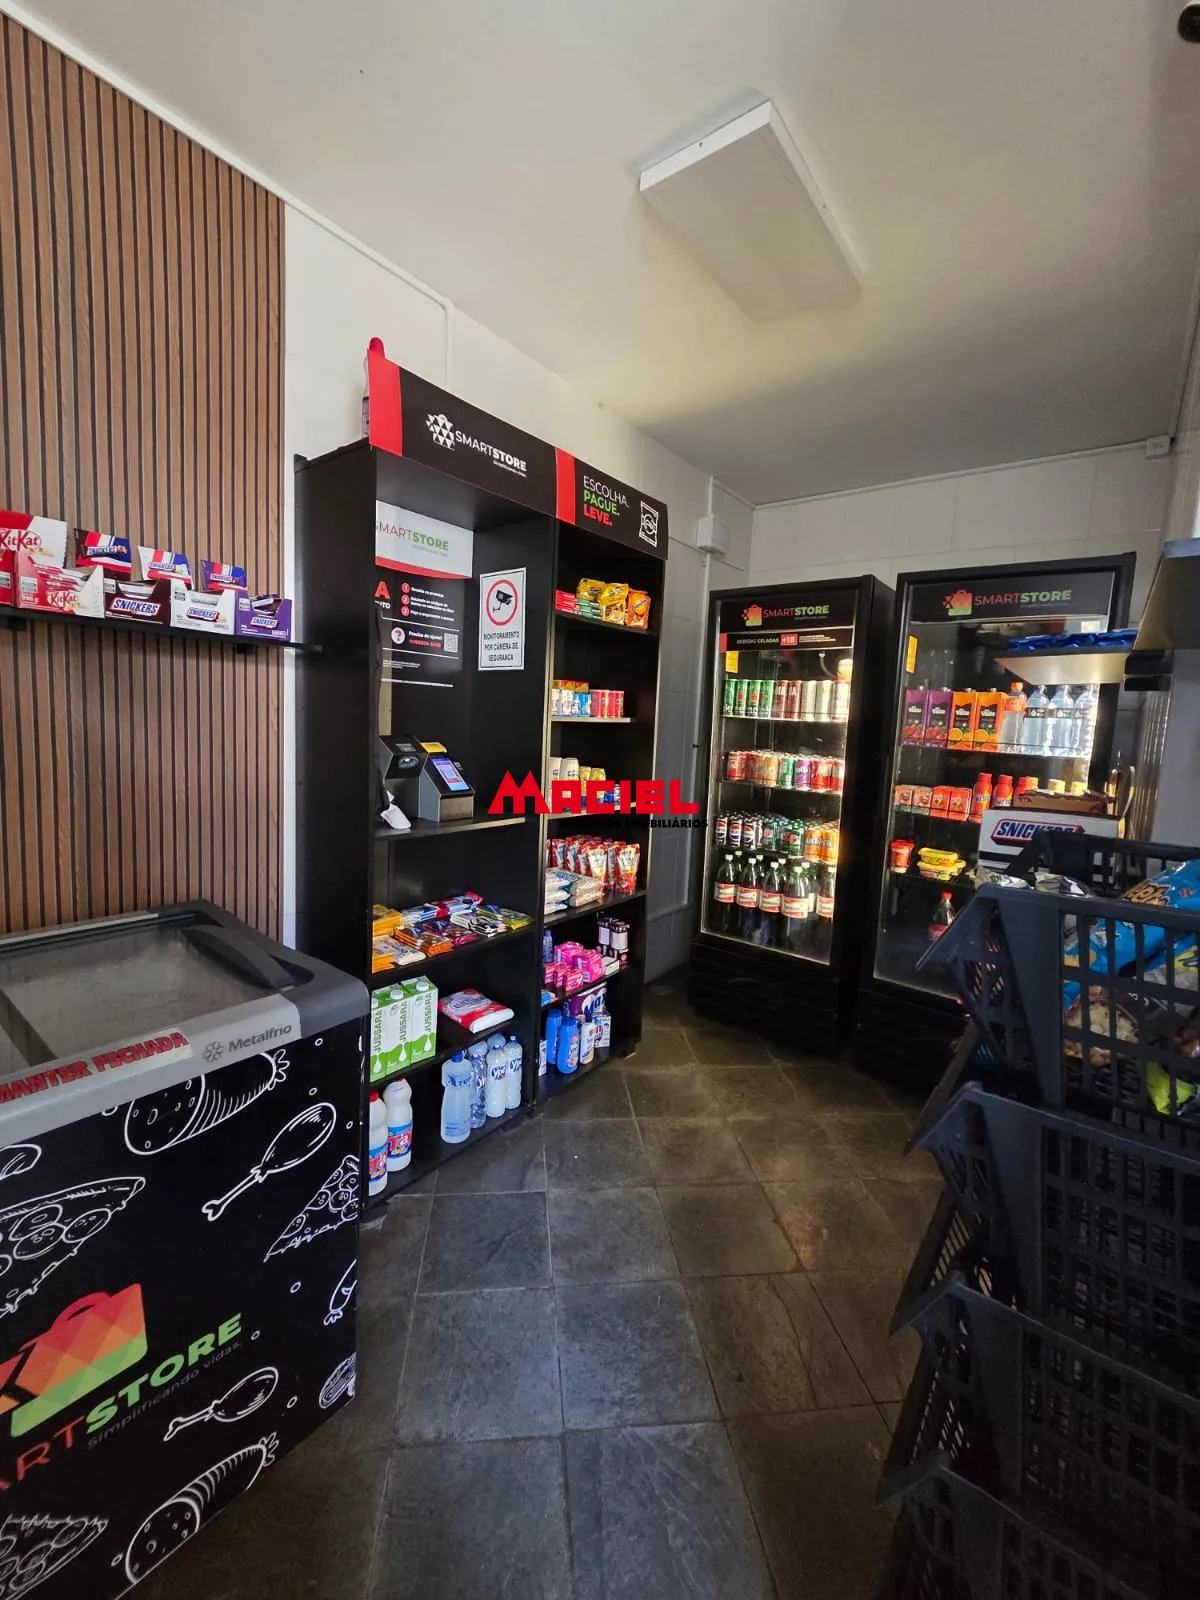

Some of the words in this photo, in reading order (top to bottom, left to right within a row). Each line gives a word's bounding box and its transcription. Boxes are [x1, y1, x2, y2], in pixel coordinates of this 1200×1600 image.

[455, 430, 527, 472] SMARTSTORE
[583, 475, 630, 508] ESCOLHA.
[583, 488, 620, 517] PAGUE.
[583, 503, 613, 527] LEVE.
[113, 599, 158, 614] SNICKERS
[763, 605, 830, 618] SMARTSTORE
[974, 589, 1072, 606] SMARTSTORE
[189, 608, 217, 619] SNICKERS
[252, 617, 276, 627] SNICKERS
[399, 1000, 408, 1042] JUSSARA
[424, 992, 433, 1032] JUSSARA
[228, 1024, 292, 1053] Metalfrio
[373, 1008, 383, 1053] JUSSARA
[92, 1031, 189, 1072] FECHADA
